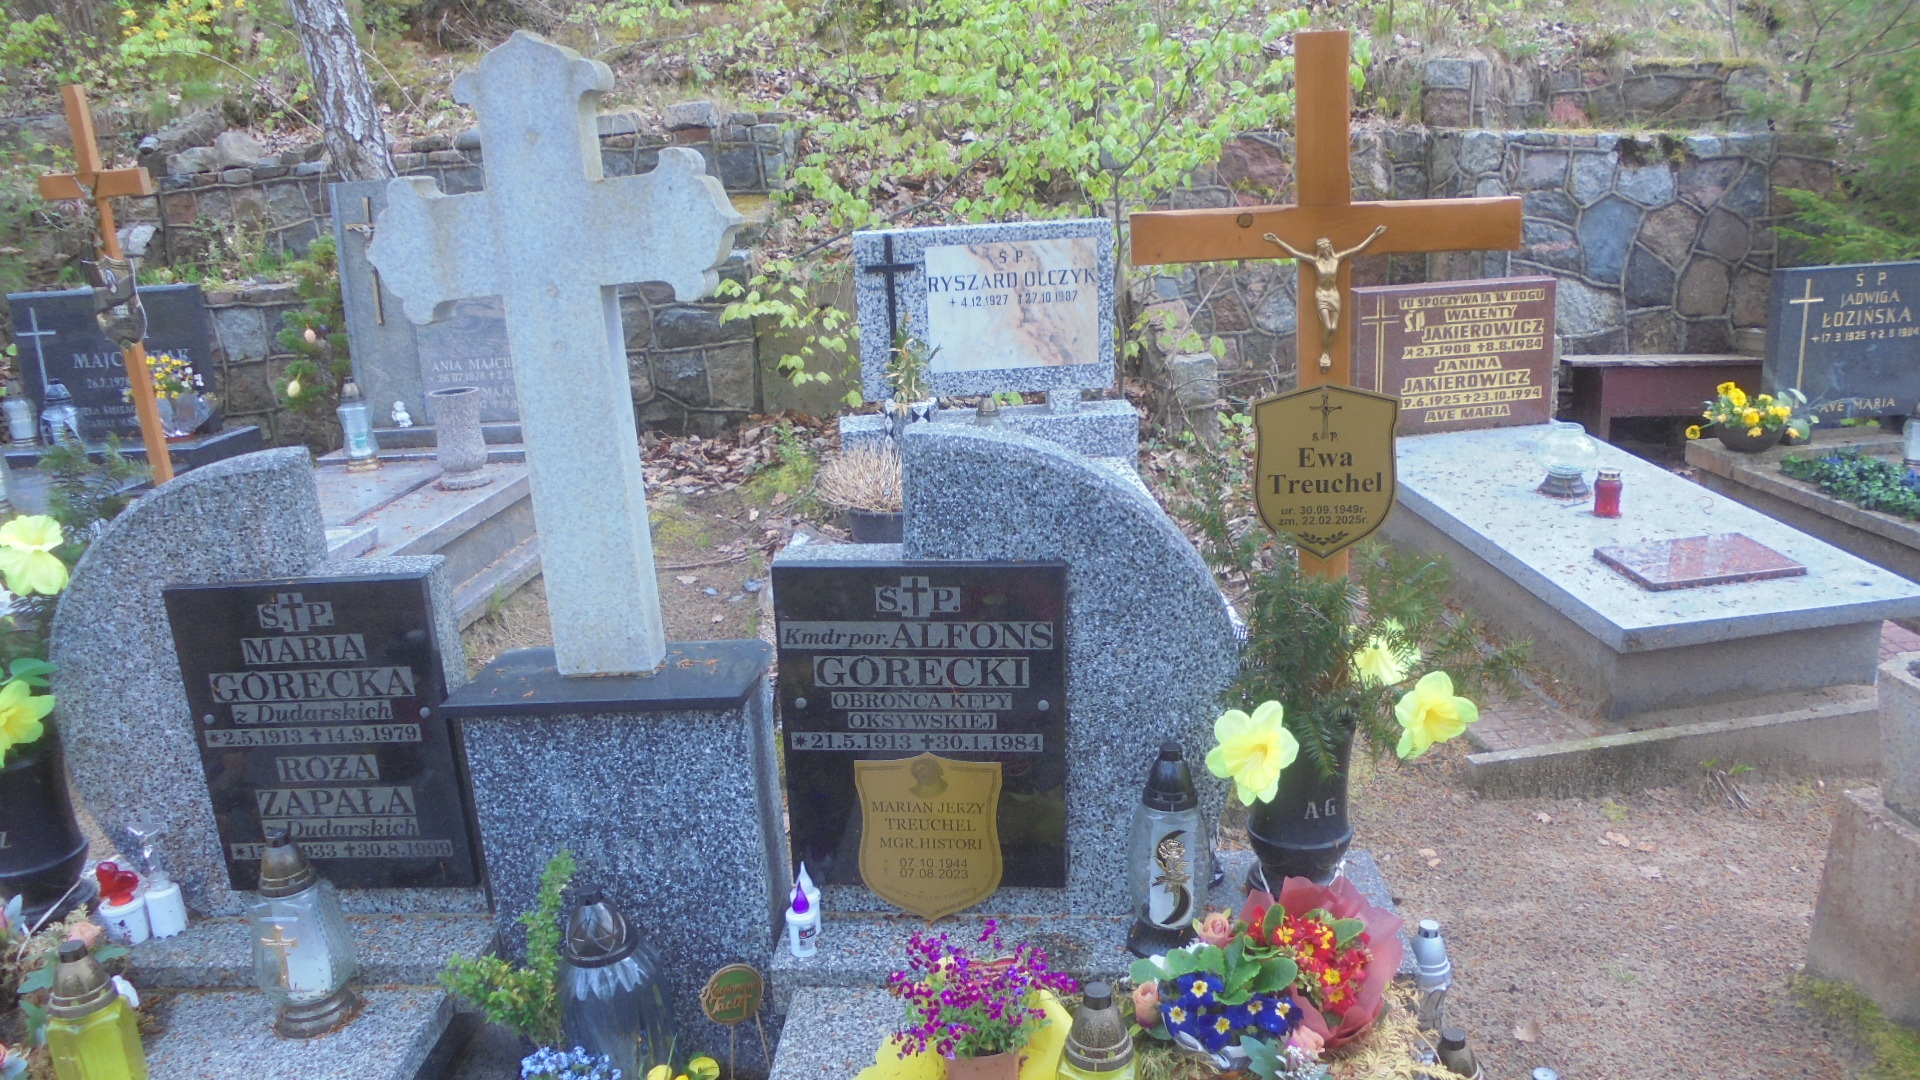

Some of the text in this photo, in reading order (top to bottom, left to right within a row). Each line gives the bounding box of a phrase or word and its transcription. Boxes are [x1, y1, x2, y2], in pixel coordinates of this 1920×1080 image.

[928, 267, 1096, 293] RYSZARD OLCZYK
[1400, 299, 1414, 308] TU
[1496, 292, 1508, 302] W
[1510, 289, 1544, 300] BOGU
[1840, 290, 1901, 309] JADWIGA
[1446, 306, 1516, 321] WALENTY
[1423, 320, 1544, 342] JAKIEROWICZ
[431, 360, 462, 373] ANIA
[1436, 357, 1499, 372] JANINA
[1402, 370, 1530, 393] JAKIEROWICZ
[1426, 405, 1509, 421] AVE MARIA
[1819, 397, 1896, 413] AVE MARIA
[1298, 447, 1353, 468] Ewa
[1267, 471, 1382, 495] Treuchel
[1280, 504, 1367, 515] ur. 30.09.1949r.
[1278, 515, 1369, 526] zm. 22.02.2025r.
[891, 622, 1053, 648] ALFONS
[243, 635, 365, 664] MARIA
[816, 655, 1027, 687] GÓRECKI
[211, 668, 414, 702] GÓRECKA
[833, 690, 1010, 711] OBROŃCA KĘPY
[235, 701, 392, 723] z Dudarskich
[849, 713, 995, 729] OKSYWSKIEJ
[258, 787, 414, 816] ZAPAŁA
[871, 801, 985, 814] MARIAN JERZY
[287, 818, 419, 838] Dudarskich
[885, 818, 976, 832] TREUCHEL
